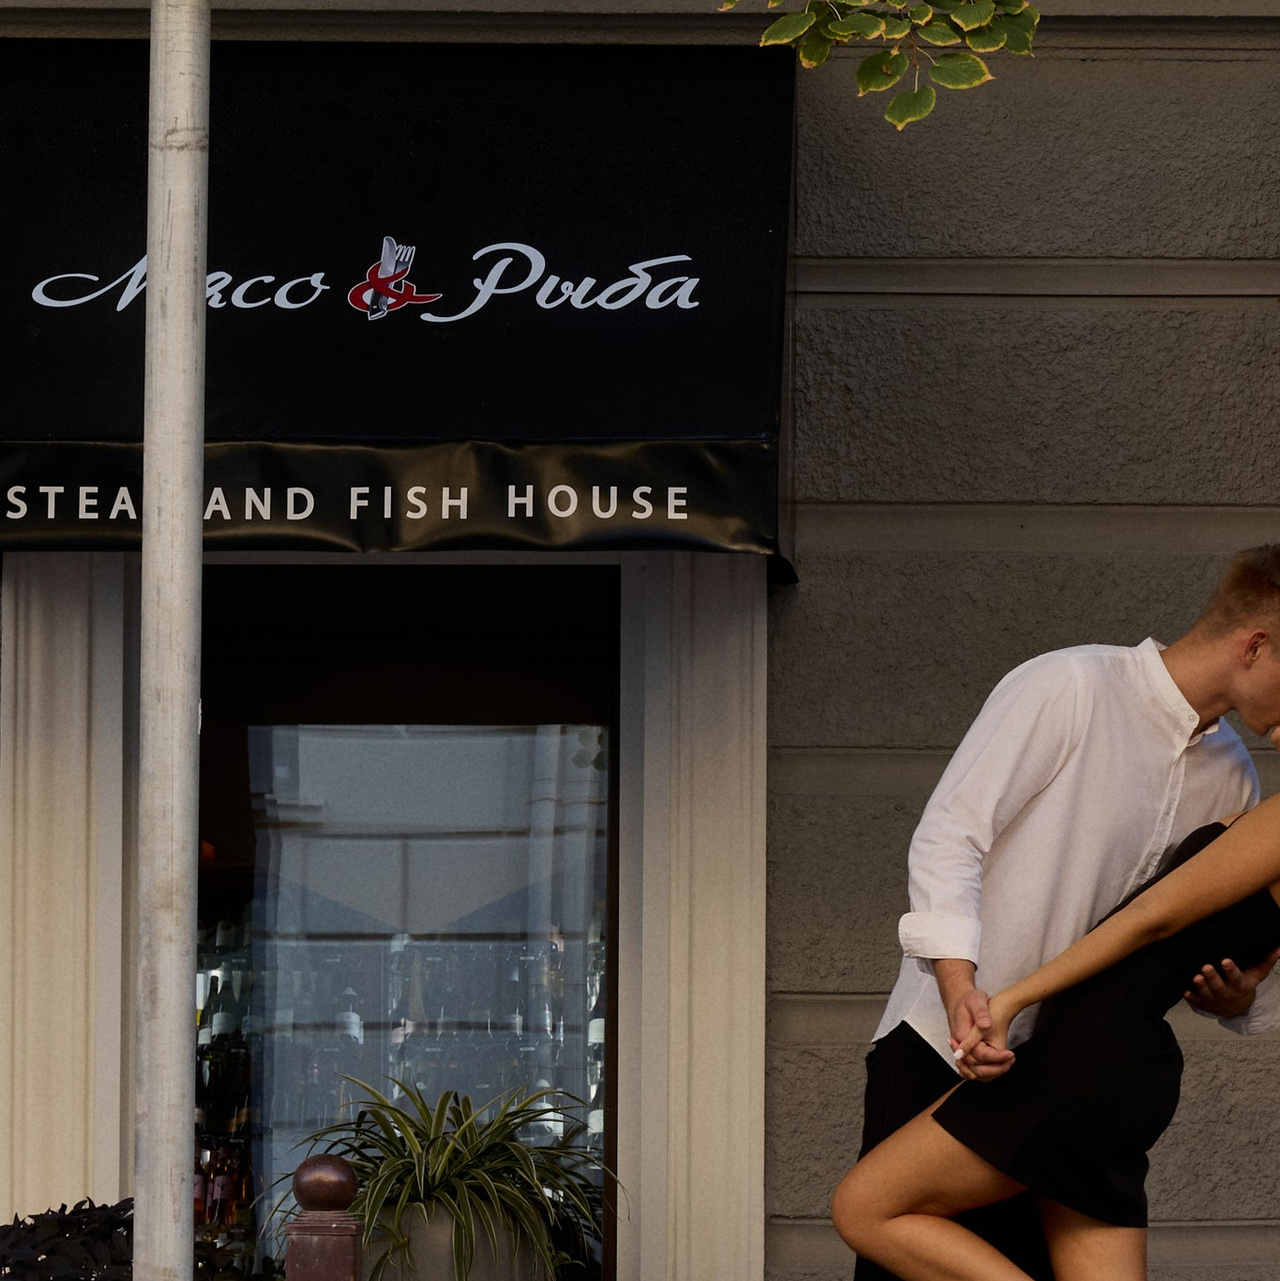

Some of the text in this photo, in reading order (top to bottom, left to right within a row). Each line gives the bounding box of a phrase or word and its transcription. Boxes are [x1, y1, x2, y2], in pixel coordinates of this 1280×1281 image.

[420, 241, 700, 323] Рыба
[6, 484, 689, 521] STEA AND FISH HOUSE
